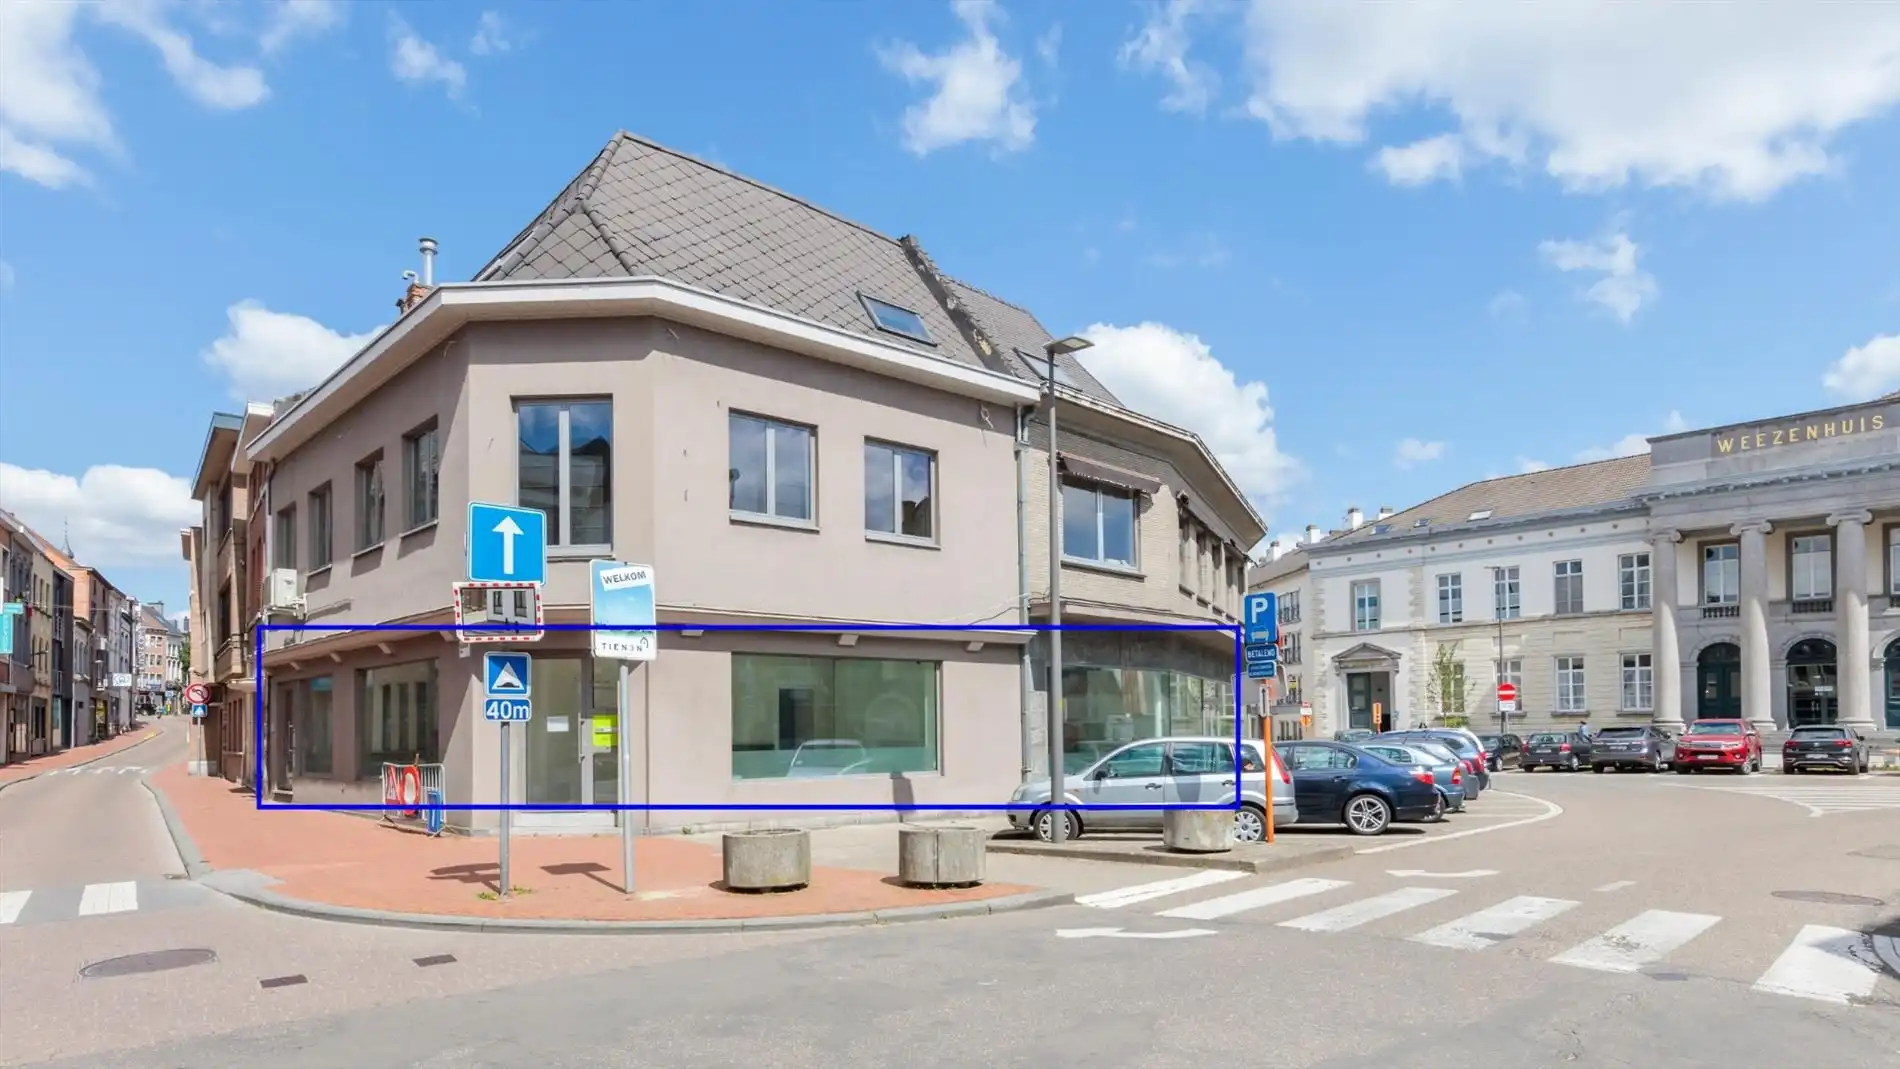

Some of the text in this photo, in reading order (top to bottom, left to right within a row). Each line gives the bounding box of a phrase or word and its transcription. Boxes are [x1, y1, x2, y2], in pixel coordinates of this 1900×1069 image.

[1717, 415, 1884, 453] WEEZENHUIS
[603, 571, 646, 584] WELKOM
[1251, 597, 1268, 623] P
[486, 700, 529, 719] 40m
